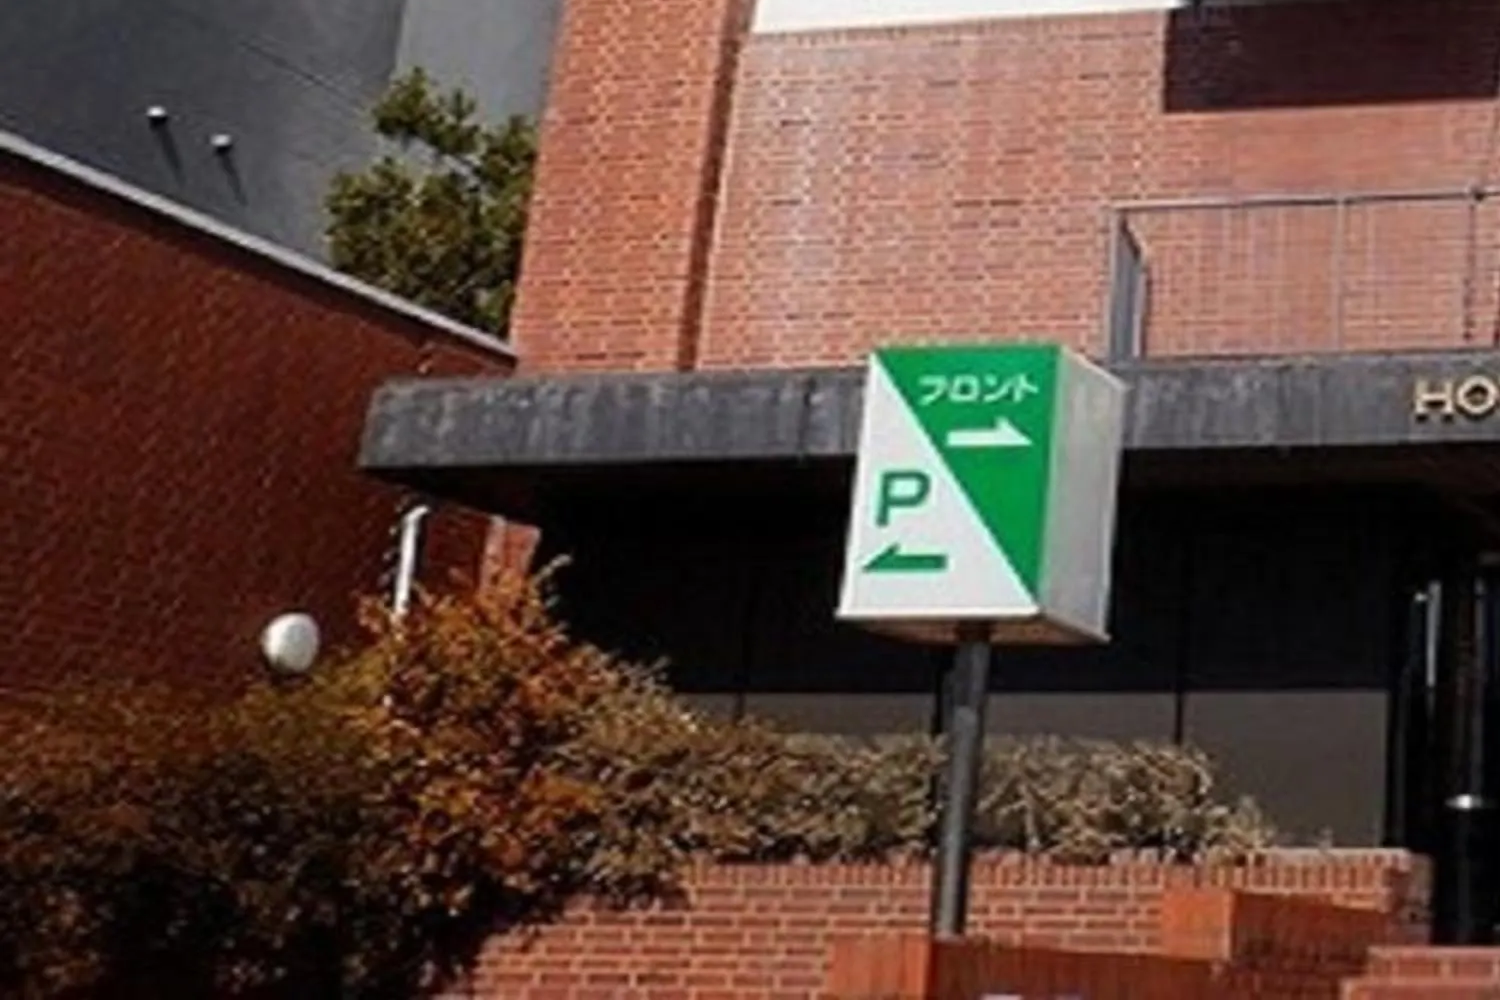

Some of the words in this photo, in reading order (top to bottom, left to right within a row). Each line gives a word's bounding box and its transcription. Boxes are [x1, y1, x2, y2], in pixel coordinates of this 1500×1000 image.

[917, 373, 1040, 405] フロント
[875, 469, 932, 527] P
